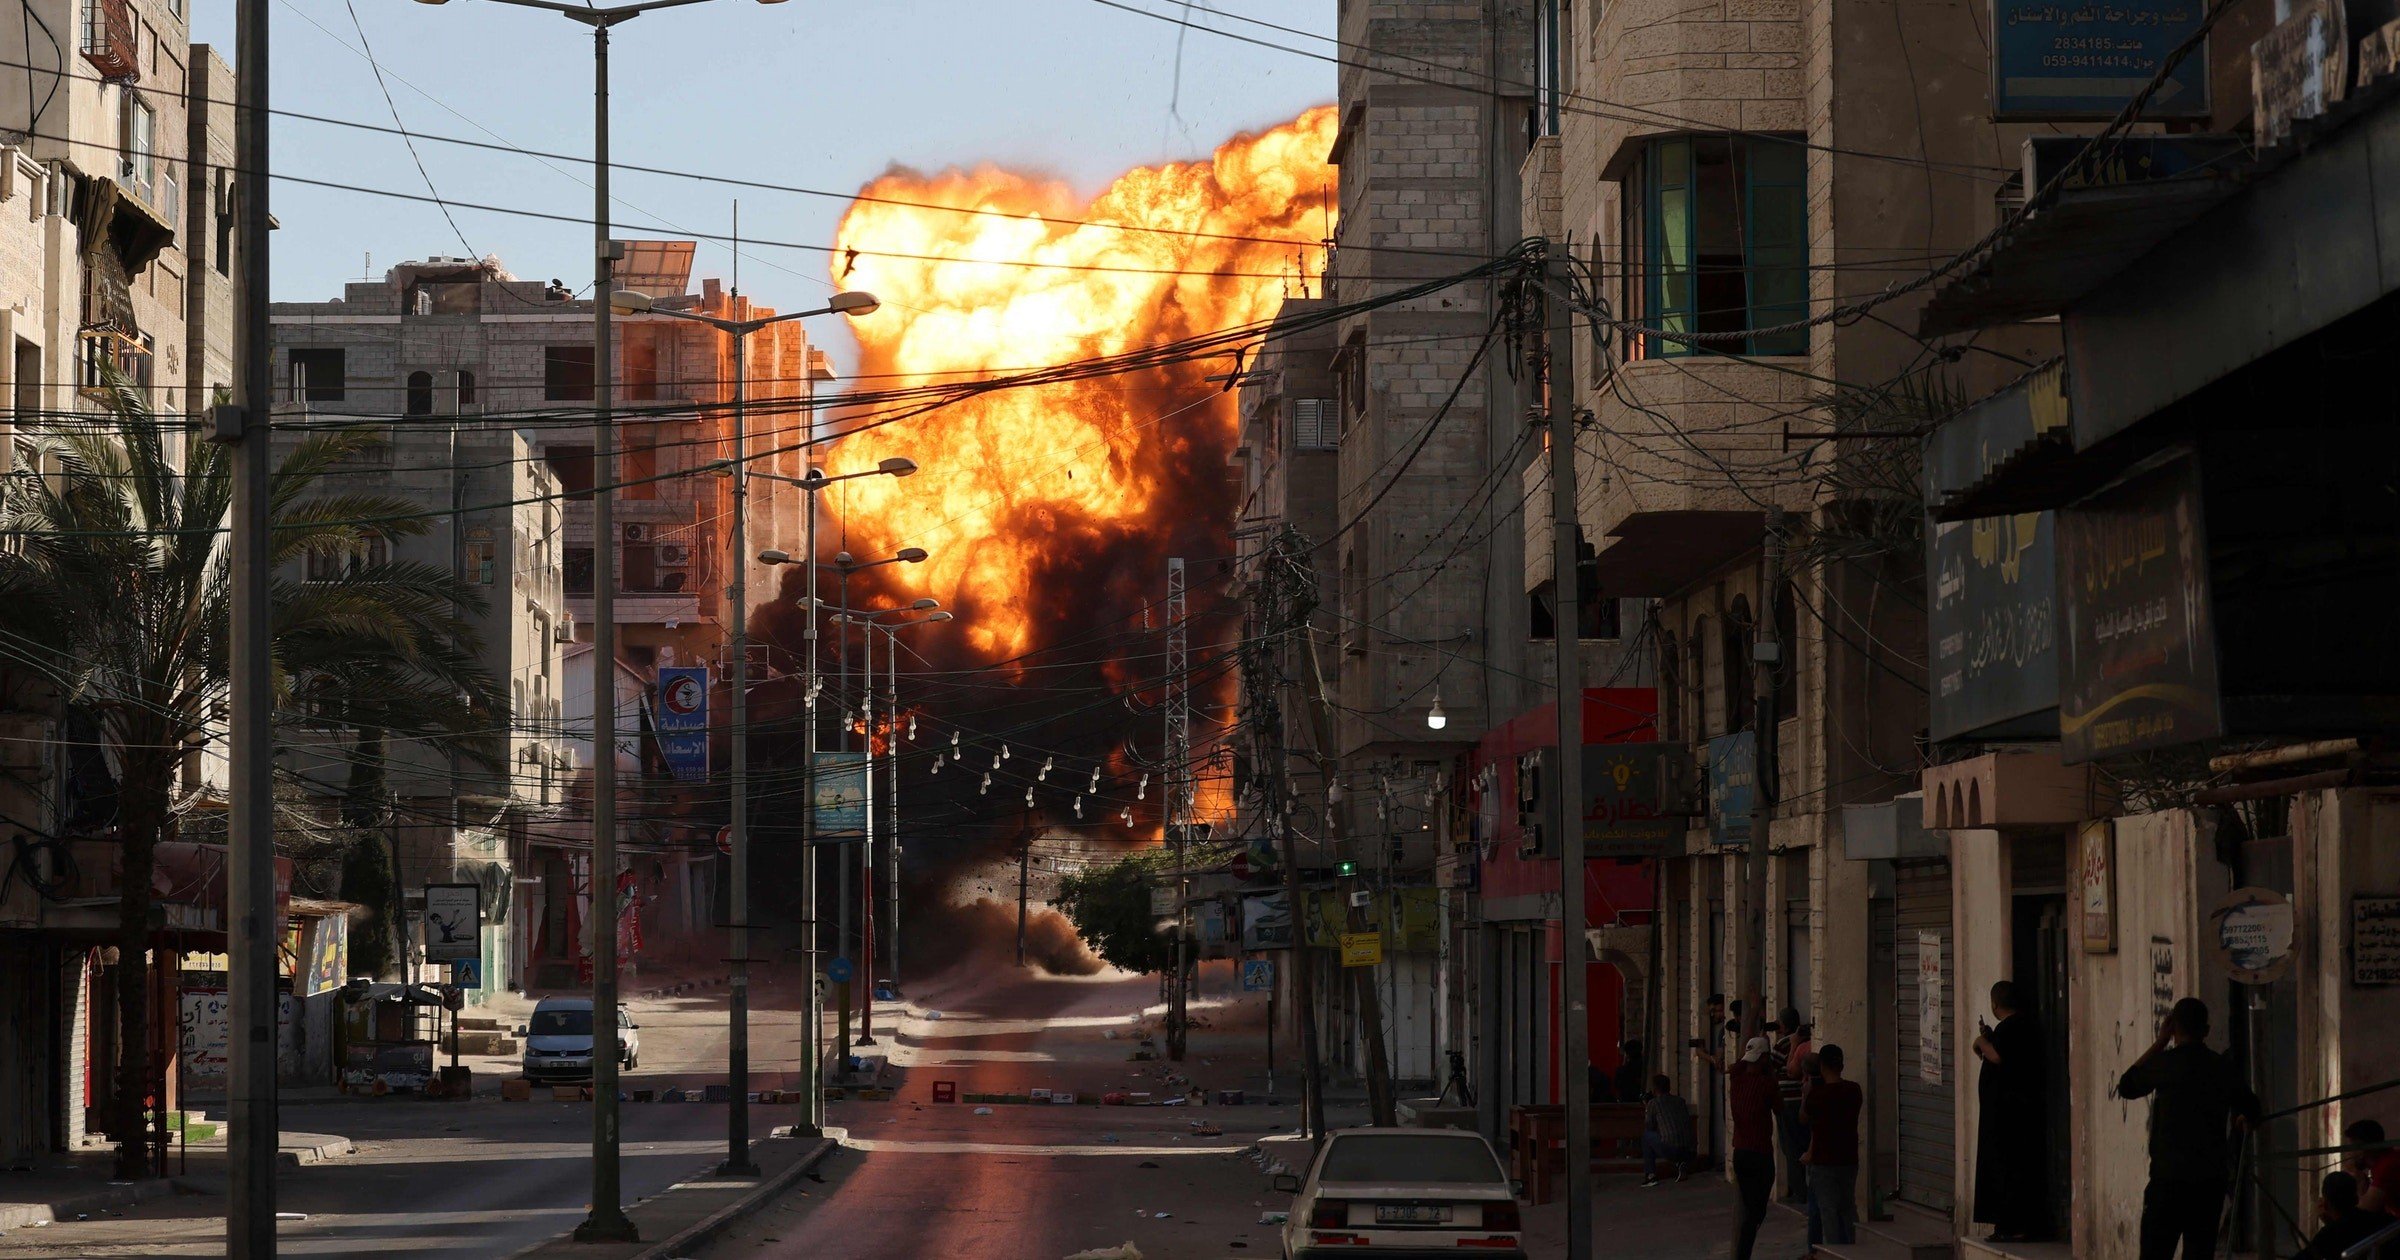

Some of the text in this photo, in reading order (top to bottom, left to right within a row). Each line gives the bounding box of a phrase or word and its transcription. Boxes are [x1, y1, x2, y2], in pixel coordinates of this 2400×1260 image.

[2071, 4, 2101, 27] الفم
[2105, 4, 2159, 27] وجراحة
[660, 717, 705, 736] صيدلية
